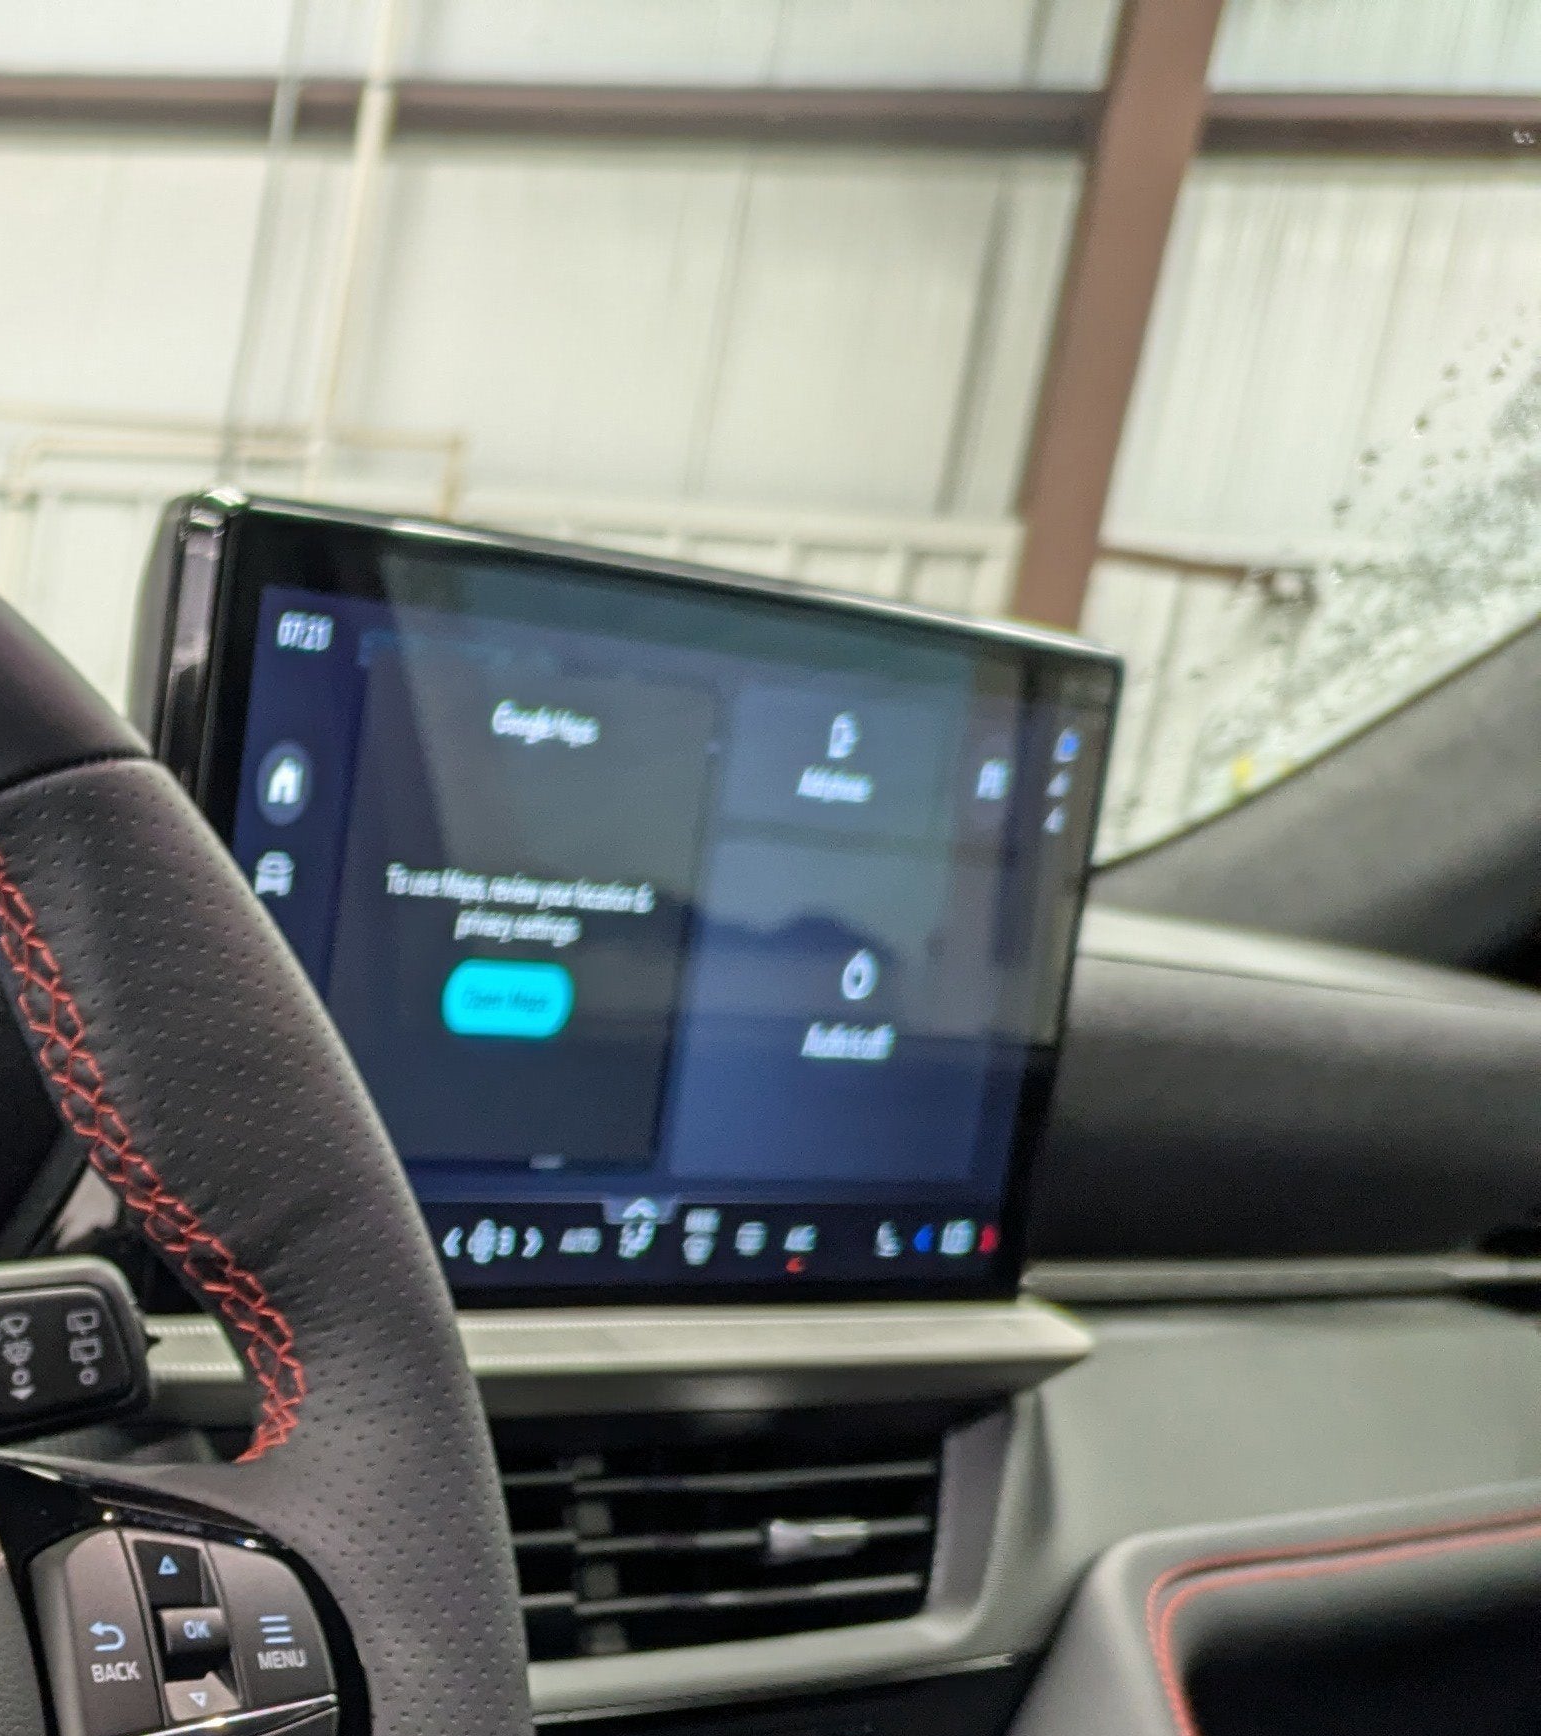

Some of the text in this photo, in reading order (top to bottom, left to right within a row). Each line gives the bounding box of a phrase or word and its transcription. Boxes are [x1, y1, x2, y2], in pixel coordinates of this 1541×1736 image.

[183, 1618, 212, 1640] OK
[90, 1660, 141, 1684] BACK
[257, 1648, 308, 1672] MENU
